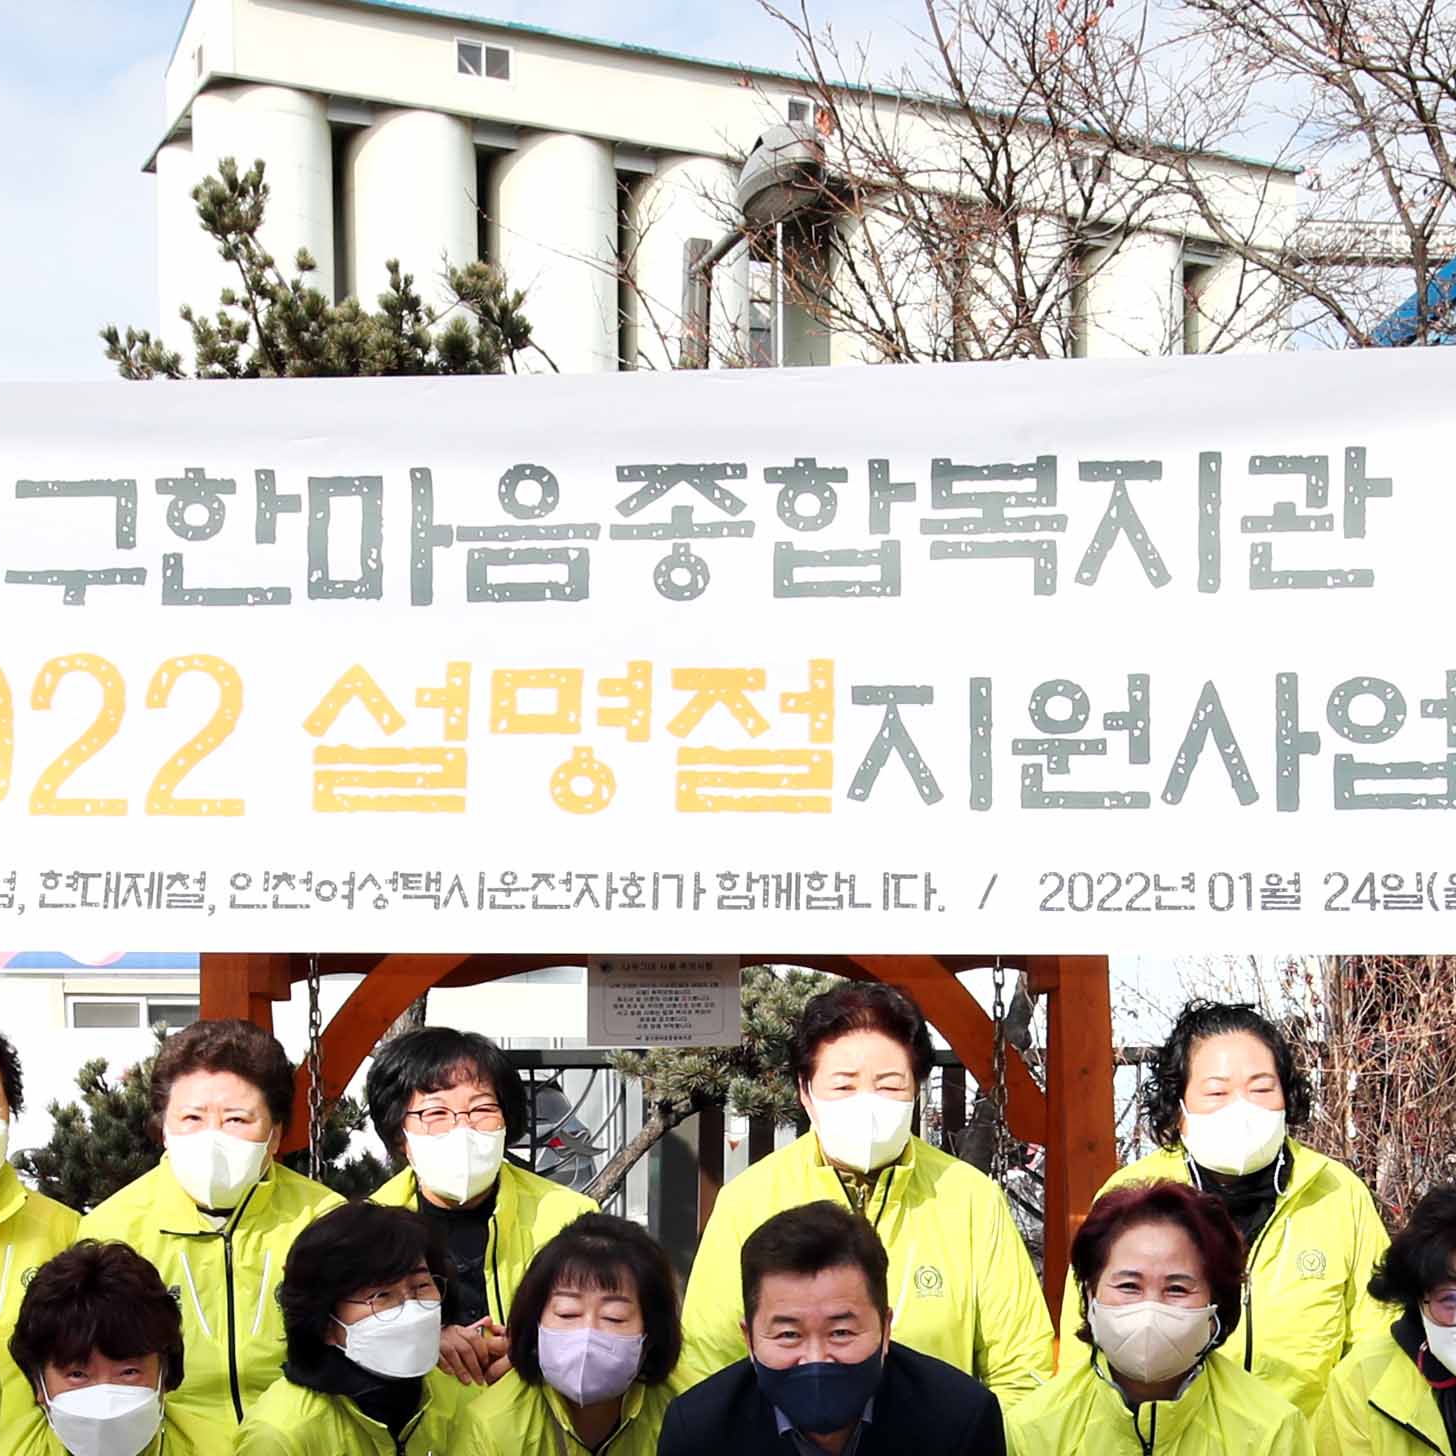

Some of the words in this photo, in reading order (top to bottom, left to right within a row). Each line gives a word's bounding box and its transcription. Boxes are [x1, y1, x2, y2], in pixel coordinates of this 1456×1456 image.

[39, 870, 217, 917] 현대제철,
[230, 871, 708, 912] 인천여성택시운전자회가
[716, 872, 946, 914] 함께합니다.
[979, 875, 999, 911] /
[1040, 872, 1197, 913] 2022년
[1209, 872, 1303, 913] 01월
